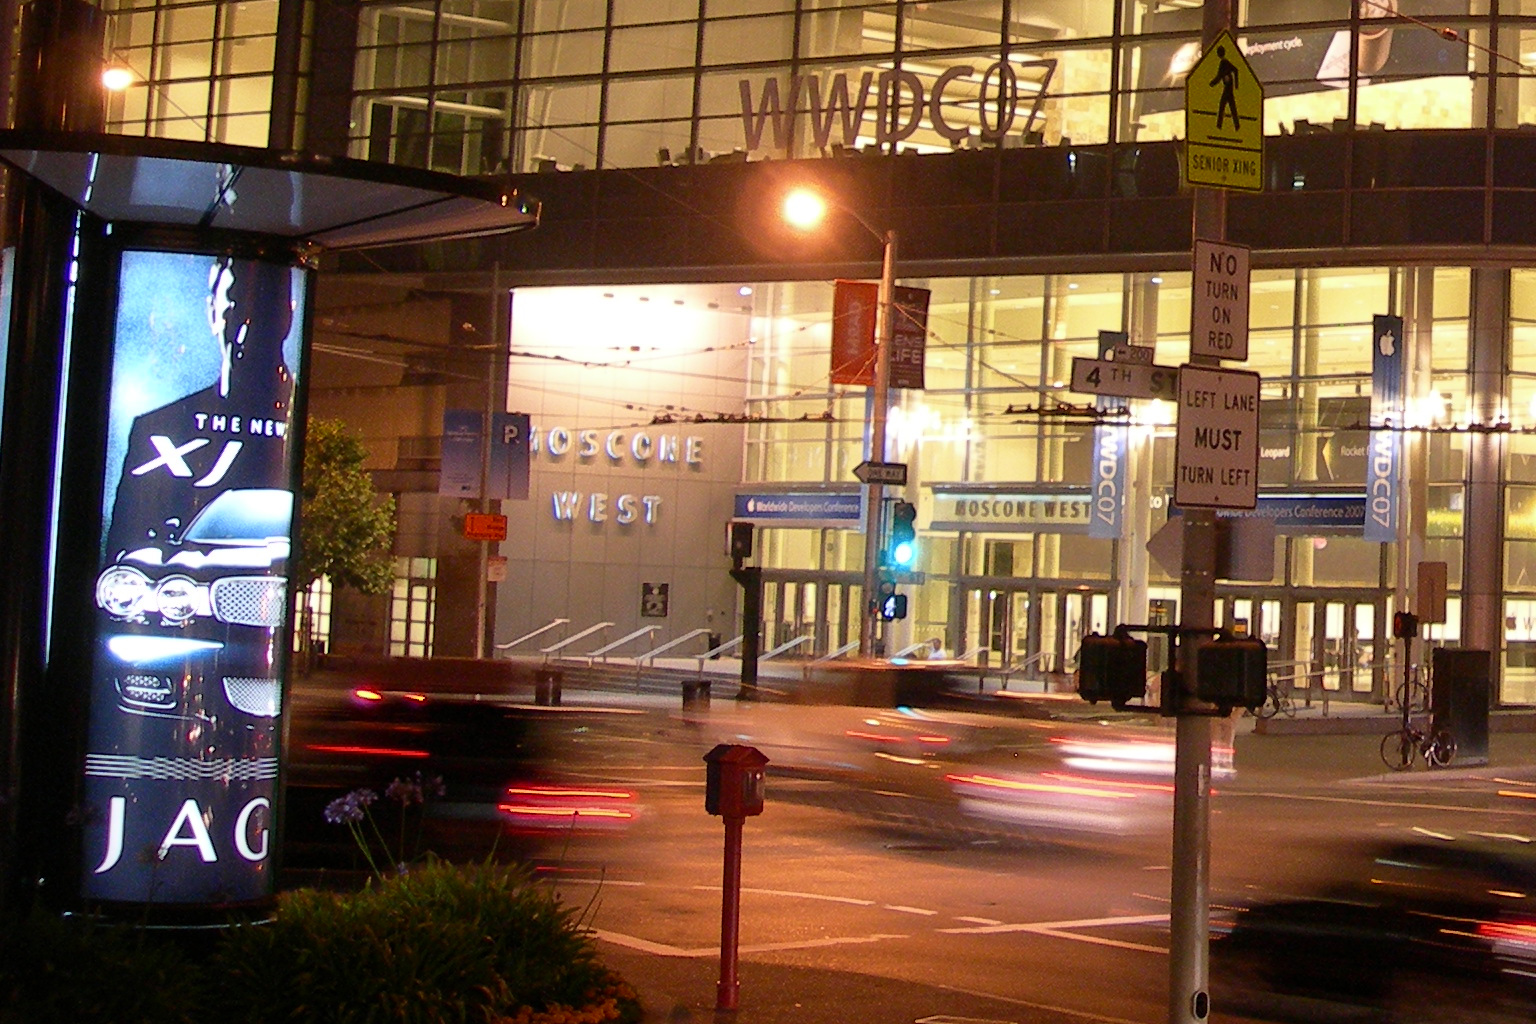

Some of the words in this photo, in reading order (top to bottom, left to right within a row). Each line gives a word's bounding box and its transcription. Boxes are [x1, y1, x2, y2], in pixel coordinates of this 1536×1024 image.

[1246, 41, 1283, 56] eployment
[738, 59, 1058, 151] WWDC07
[1192, 154, 1230, 174] SENIOR
[1232, 159, 1257, 176] XING
[1210, 253, 1238, 276] NO
[1206, 281, 1238, 300] TURN
[1212, 306, 1231, 324] ON
[1208, 330, 1233, 350] RED
[1186, 390, 1216, 409] LEFT
[1224, 393, 1255, 412] LANE
[195, 413, 241, 433] THE
[250, 418, 288, 437] NEW
[1194, 427, 1242, 451] MUST
[131, 435, 244, 487] XJ
[1260, 445, 1291, 461] Leopard
[1181, 465, 1214, 484] TURN
[1221, 468, 1250, 487] LEFT
[1372, 426, 1393, 529] WDC07
[552, 490, 664, 524] WEST
[954, 500, 1038, 518] MOSCONE
[1043, 501, 1091, 519] WEST
[1294, 504, 1344, 519] Conference
[93, 796, 271, 874] JAG
